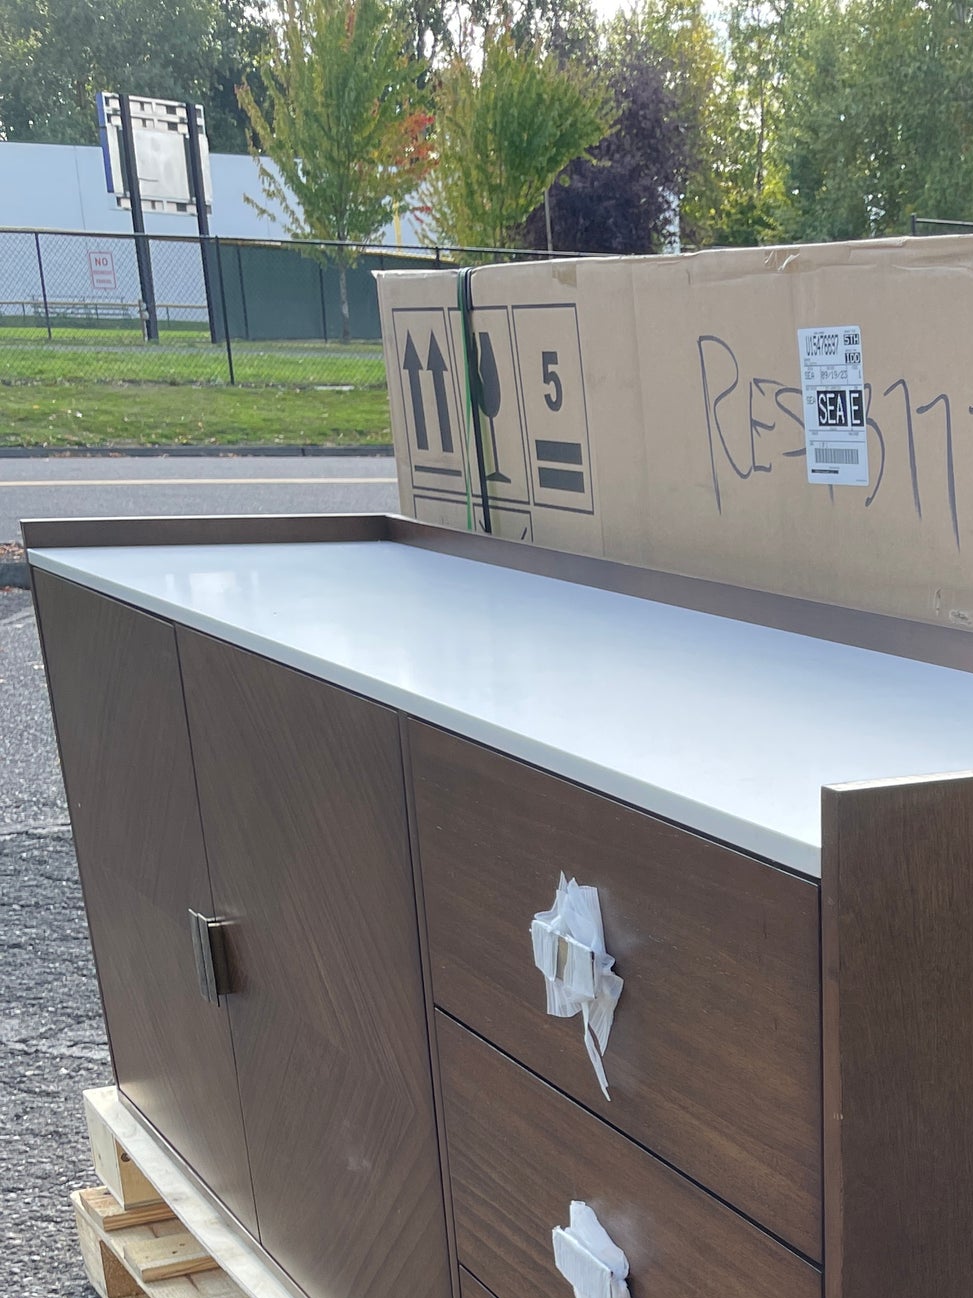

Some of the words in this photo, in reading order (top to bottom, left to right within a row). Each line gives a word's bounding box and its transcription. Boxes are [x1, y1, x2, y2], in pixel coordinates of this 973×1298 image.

[95, 257, 108, 267] NO
[541, 351, 563, 412] 5
[819, 393, 845, 424] SEA
[851, 393, 861, 424] E
